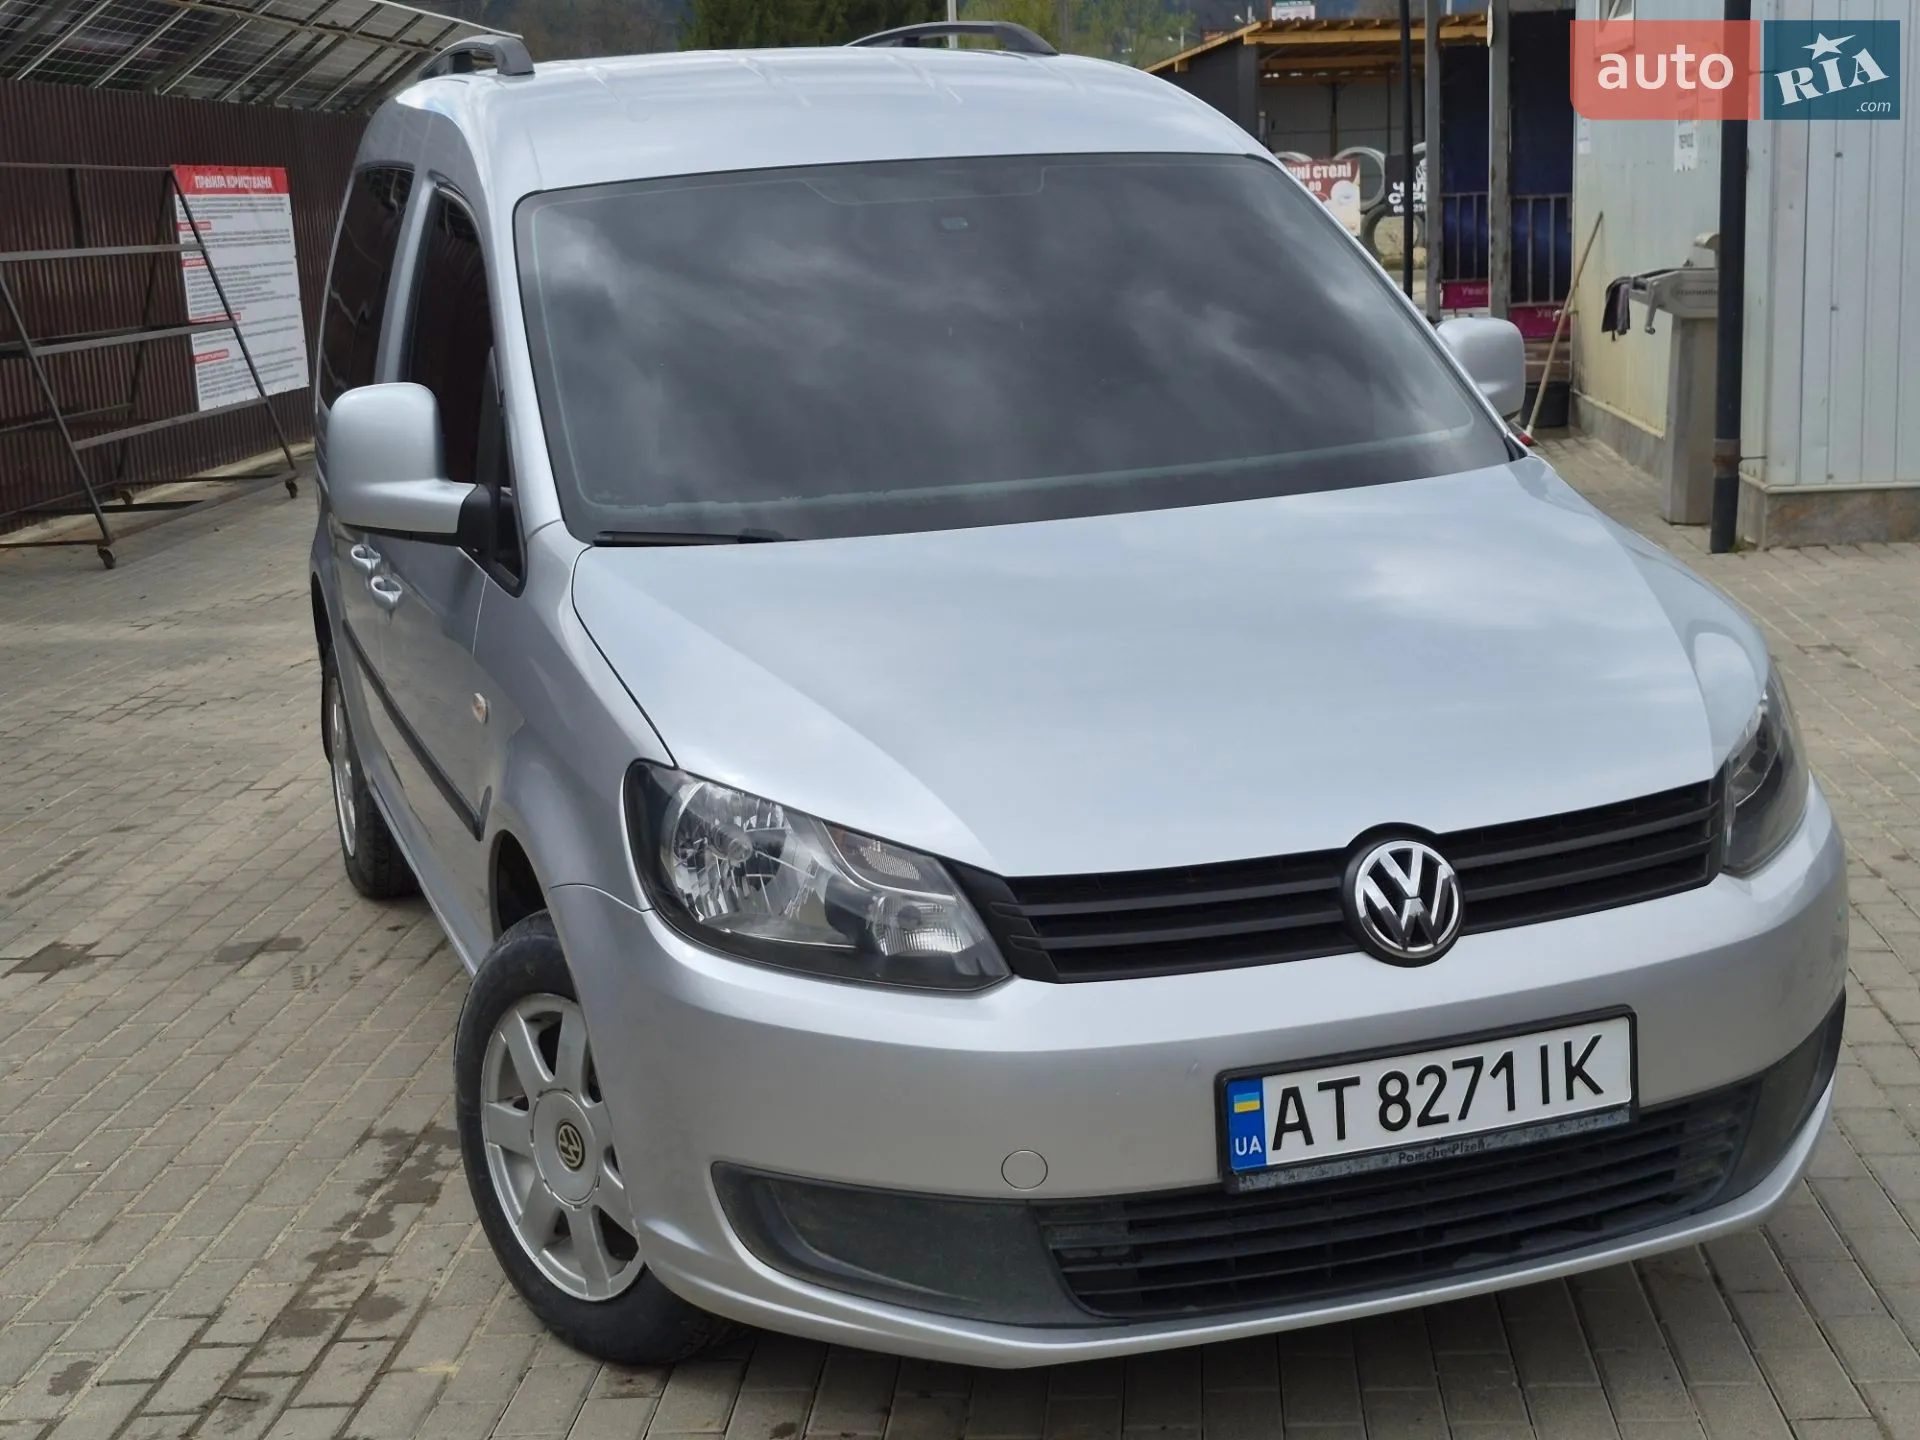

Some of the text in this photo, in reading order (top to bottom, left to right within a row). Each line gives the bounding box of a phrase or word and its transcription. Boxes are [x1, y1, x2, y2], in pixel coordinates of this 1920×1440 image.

[1272, 1034, 1604, 1152] AT 8271 IK
[1234, 1136, 1263, 1157] UA
